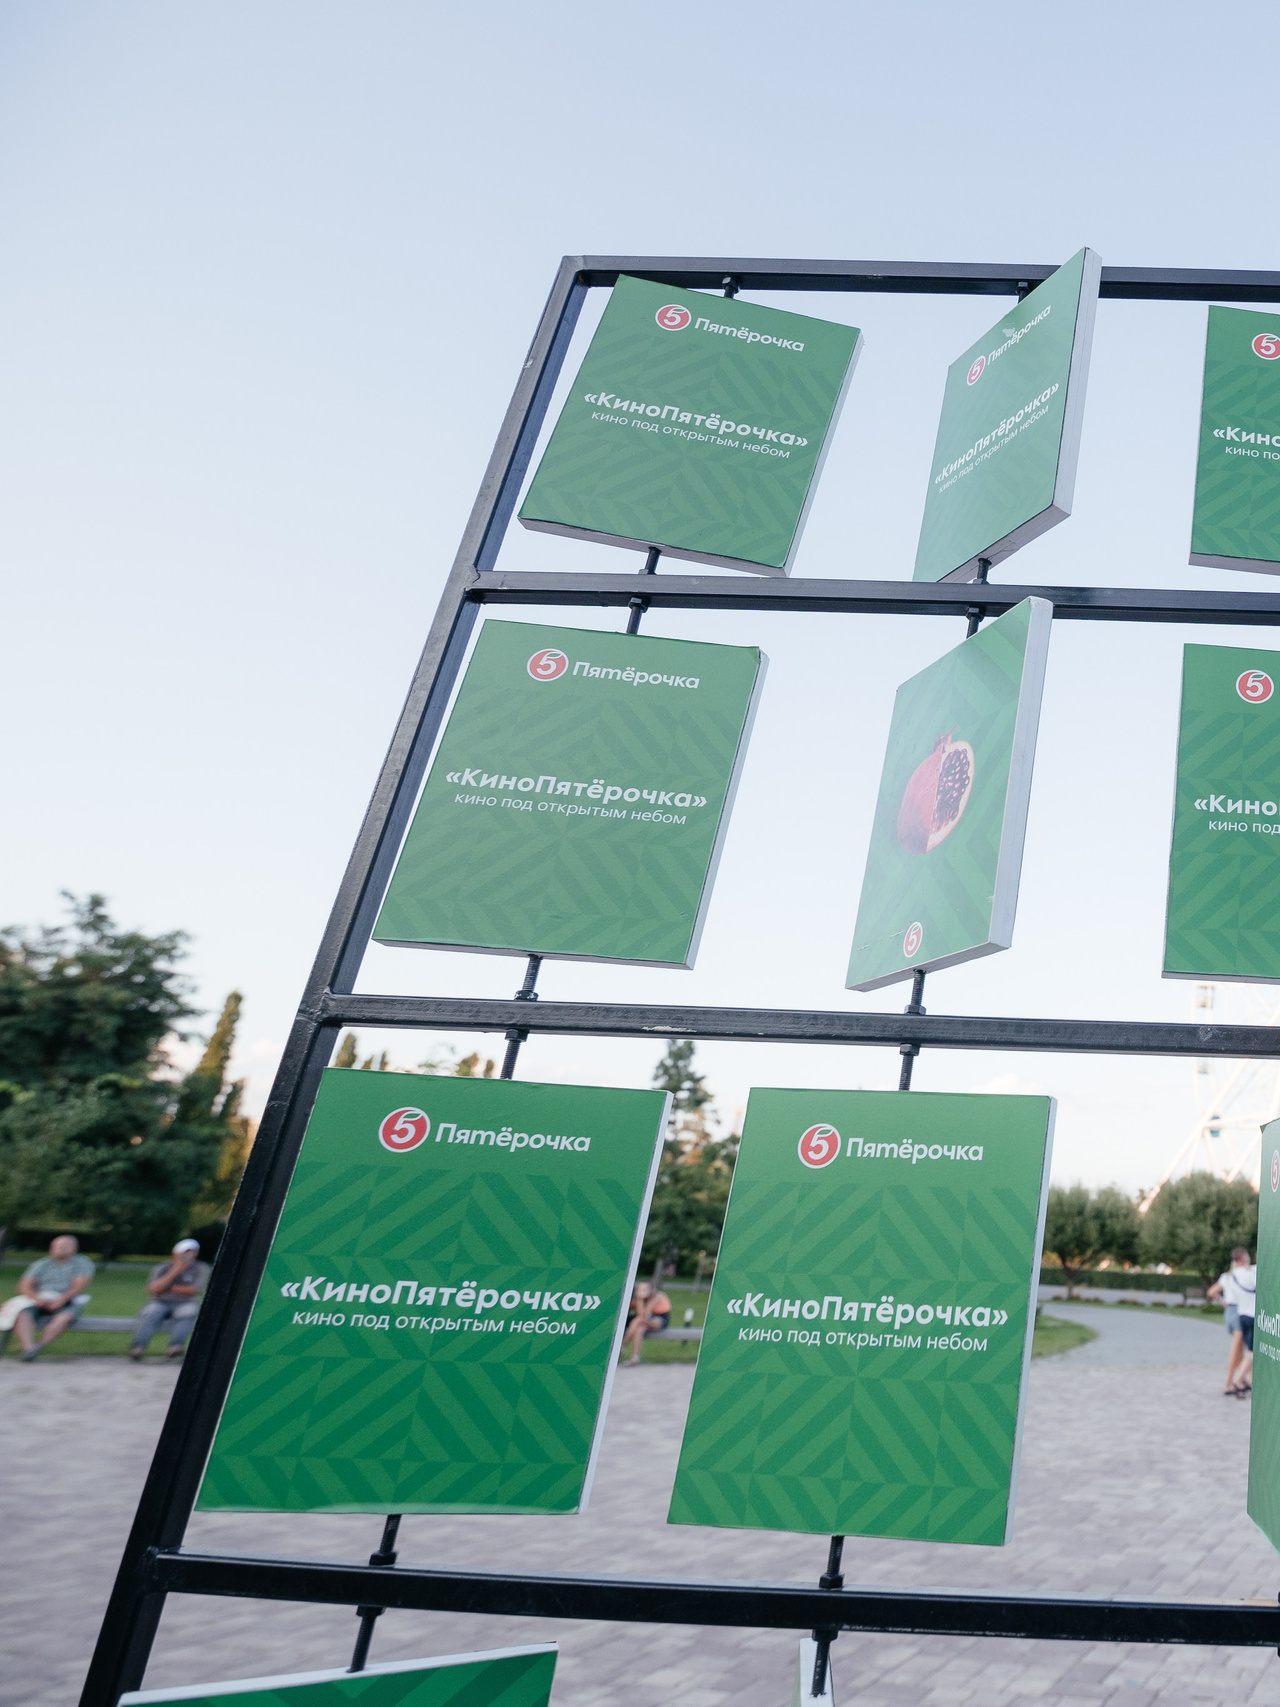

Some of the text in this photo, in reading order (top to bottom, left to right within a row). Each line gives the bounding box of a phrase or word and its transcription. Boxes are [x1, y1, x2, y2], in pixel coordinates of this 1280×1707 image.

[695, 318, 804, 351] Пятёрочка
[988, 306, 1050, 365] Пятёрочка
[585, 392, 808, 446] «КиноПятёрочка»
[592, 412, 790, 458] кино под открытым небом
[936, 383, 1059, 483] «КиноПятёрочка»
[940, 405, 1048, 493] кино под открытым небом
[1226, 447, 1259, 457] кино
[573, 662, 699, 688] Пятёрочка
[446, 768, 707, 807] «КиноПятёрочка»
[455, 794, 686, 824] кино под открытым небом
[1209, 821, 1247, 831] кино
[1253, 823, 1280, 835] под
[436, 1123, 591, 1152] Пятёрочка
[847, 1138, 983, 1164] Пятёрочка
[281, 1276, 601, 1314] «КиноПятёрочка»
[727, 1293, 1008, 1329] «КиноПятёрочка»
[293, 1312, 576, 1334] кино под открытым небом
[739, 1328, 987, 1351] кино под открытым небом
